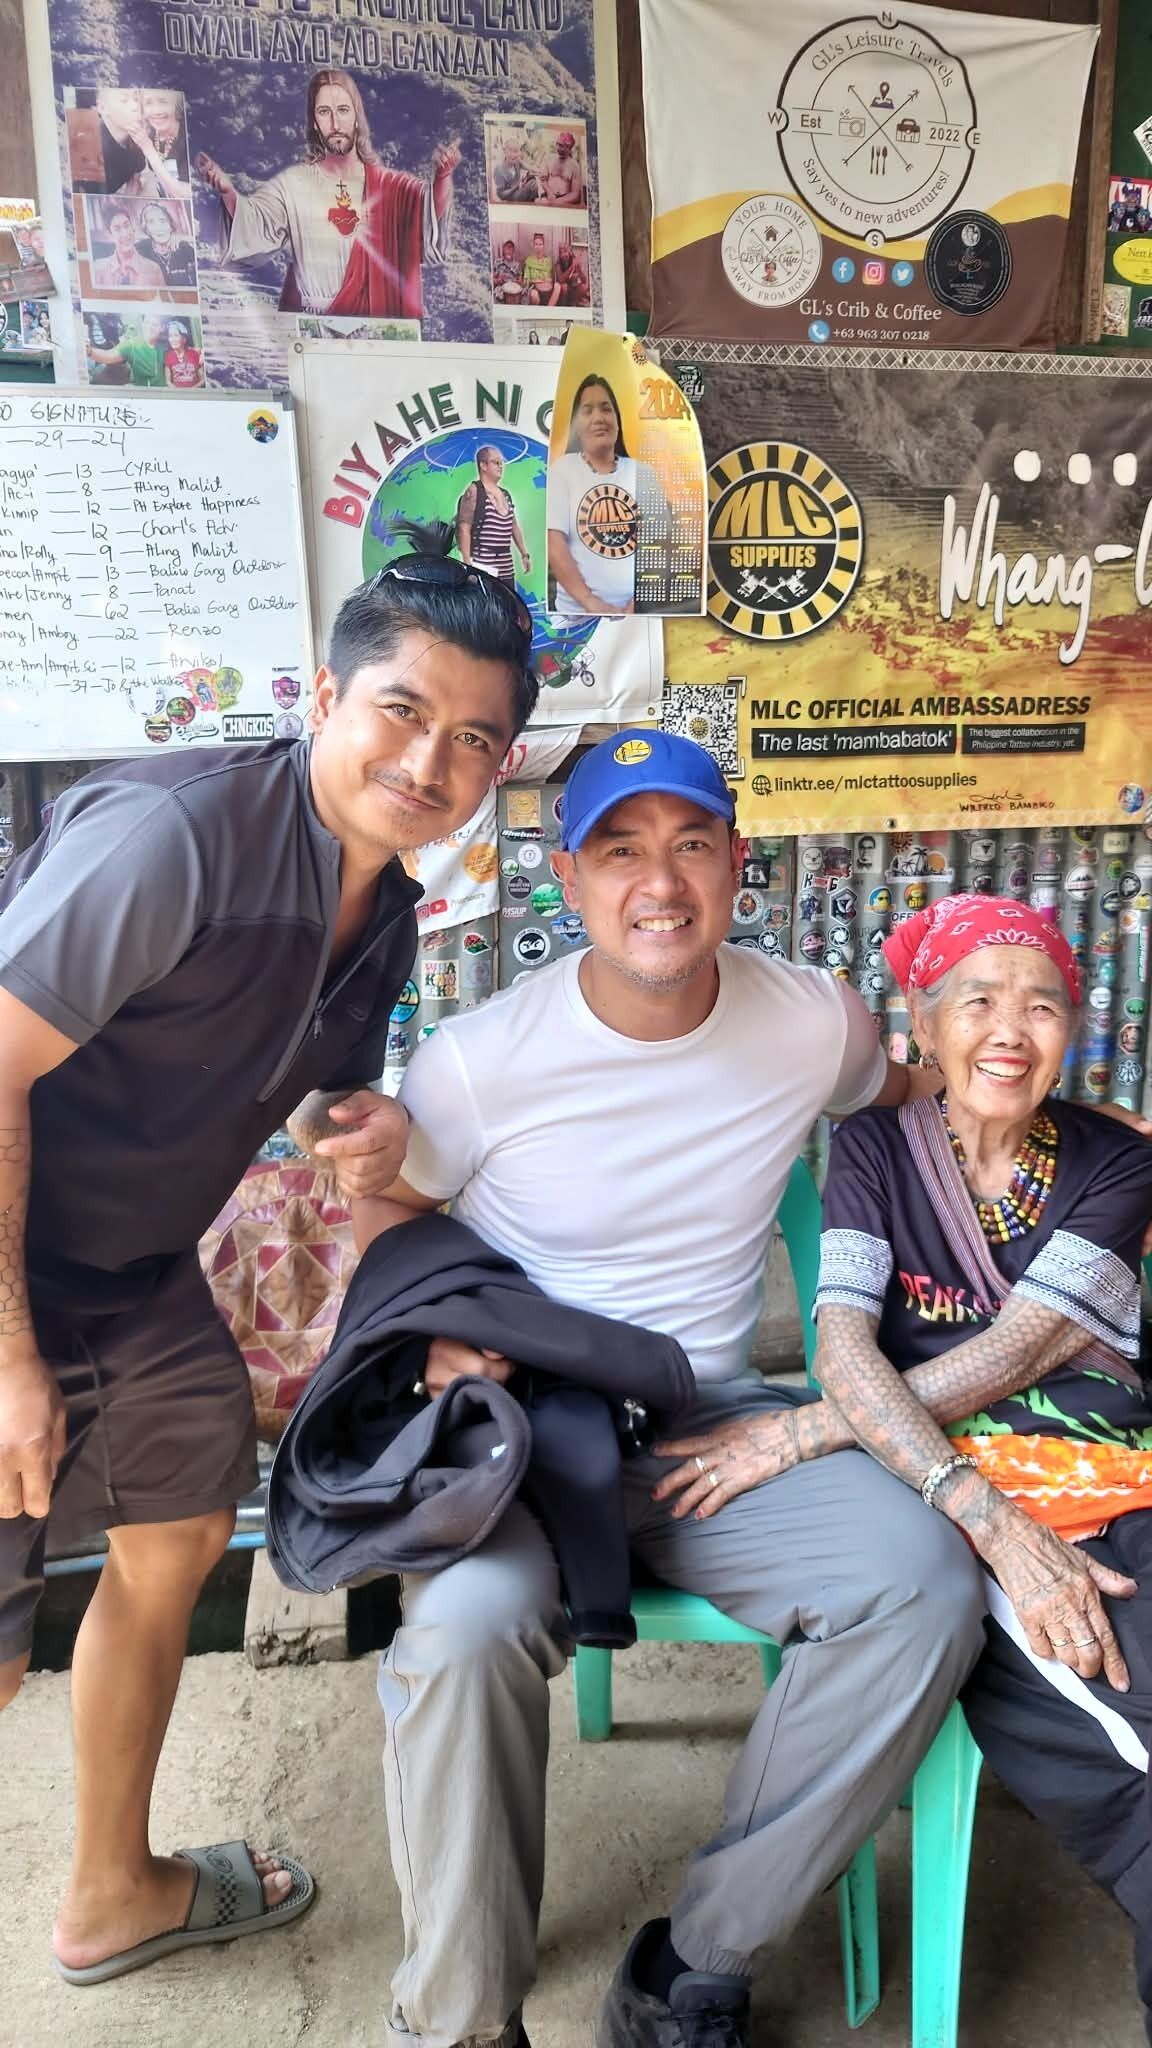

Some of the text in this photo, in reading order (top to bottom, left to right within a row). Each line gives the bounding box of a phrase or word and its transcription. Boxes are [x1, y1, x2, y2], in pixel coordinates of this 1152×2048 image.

[882, 12, 892, 22] N
[163, 12, 261, 60] OMALI
[270, 20, 331, 65] AYO
[343, 25, 382, 68] AD
[811, 31, 953, 88] GL's Leisure Travels
[768, 112, 782, 124] W
[800, 115, 960, 142] Est 2022
[973, 133, 980, 144] E
[803, 158, 950, 225] Say yes to new adventures!
[735, 201, 808, 230] YOUR HOME
[871, 234, 879, 246] S
[731, 266, 811, 301] AWAY FROM HOME
[799, 299, 942, 321] GL's Crib & Coffee
[832, 328, 930, 341] +63 963 307 0218
[323, 382, 462, 528] BIYAHE
[476, 379, 523, 427] NI
[76, 463, 92, 479] 13
[81, 482, 93, 497] 8
[87, 500, 101, 515] 12
[589, 499, 634, 522] MLC
[712, 480, 835, 538] MLC
[92, 522, 108, 541] 12
[100, 545, 112, 563] 9
[729, 544, 817, 569] SUPPLIES
[106, 565, 120, 582] 13
[109, 585, 119, 599] 8
[105, 602, 129, 620] 62
[114, 627, 139, 641] 22
[120, 656, 136, 674] 12
[751, 696, 1091, 720] MLC OFFICIAL AMBASSADRESS
[759, 729, 952, 751] The last 'mambabatok'
[968, 728, 983, 737] The
[985, 728, 1011, 739] biggest
[1012, 727, 1058, 737] collaboration
[1067, 727, 1080, 735] the
[972, 740, 1007, 750] Philippine
[1009, 740, 1030, 749] Tattoo
[775, 773, 977, 793] linktr.ee/mlctattoosupplies
